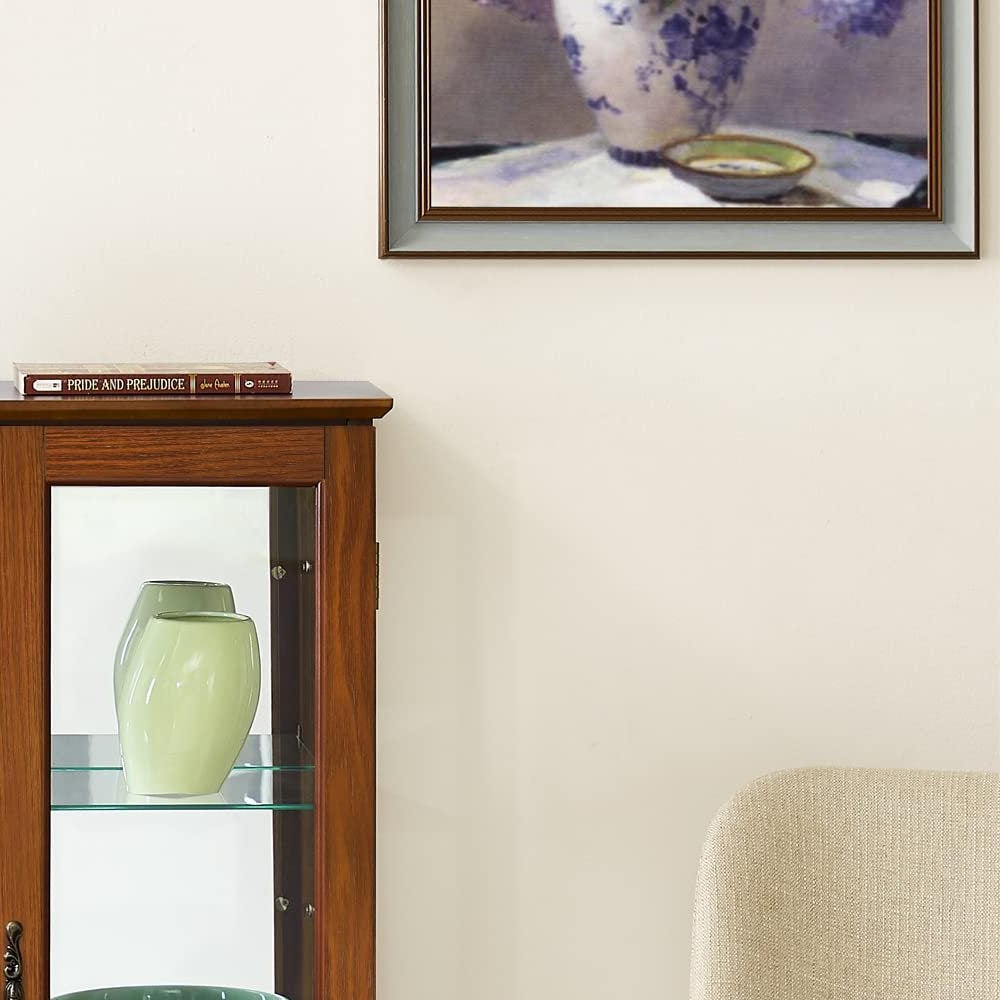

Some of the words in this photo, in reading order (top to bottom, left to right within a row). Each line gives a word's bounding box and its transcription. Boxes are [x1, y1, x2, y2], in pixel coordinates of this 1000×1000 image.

[67, 378, 99, 391] PRIDE
[101, 378, 124, 391] AND
[126, 378, 185, 391] PREJUDICE
